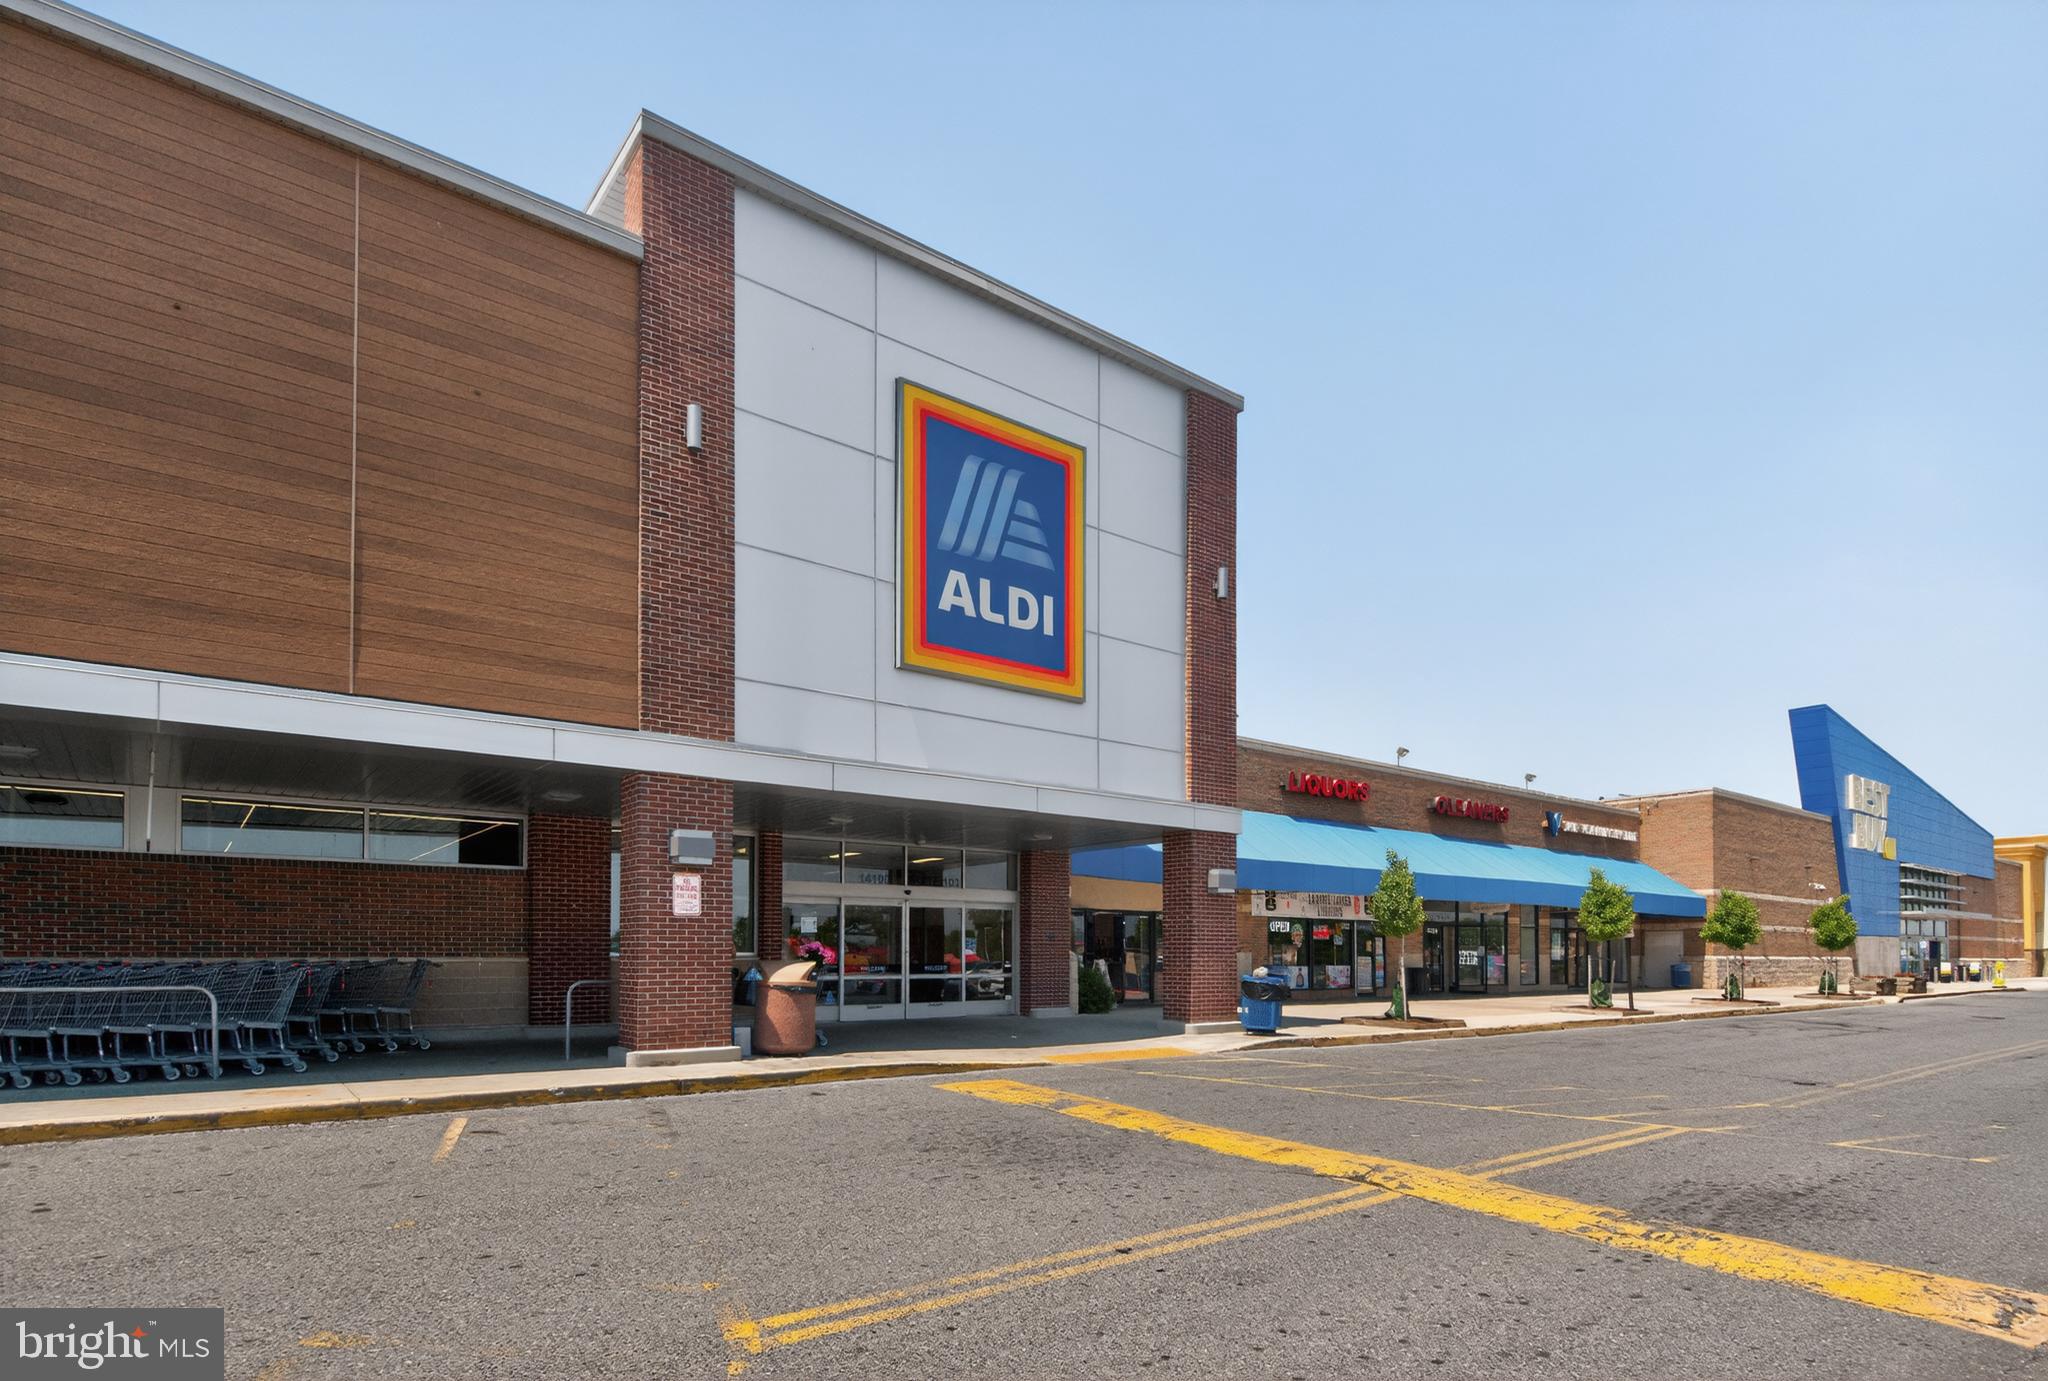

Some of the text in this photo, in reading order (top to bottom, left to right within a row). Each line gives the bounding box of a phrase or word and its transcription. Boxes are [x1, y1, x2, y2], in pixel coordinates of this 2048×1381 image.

[938, 569, 1054, 636] ALDI
[1288, 771, 1371, 801] LIQUORS
[1434, 796, 1509, 824] CLEANERS
[1269, 921, 1290, 932] OPEN
